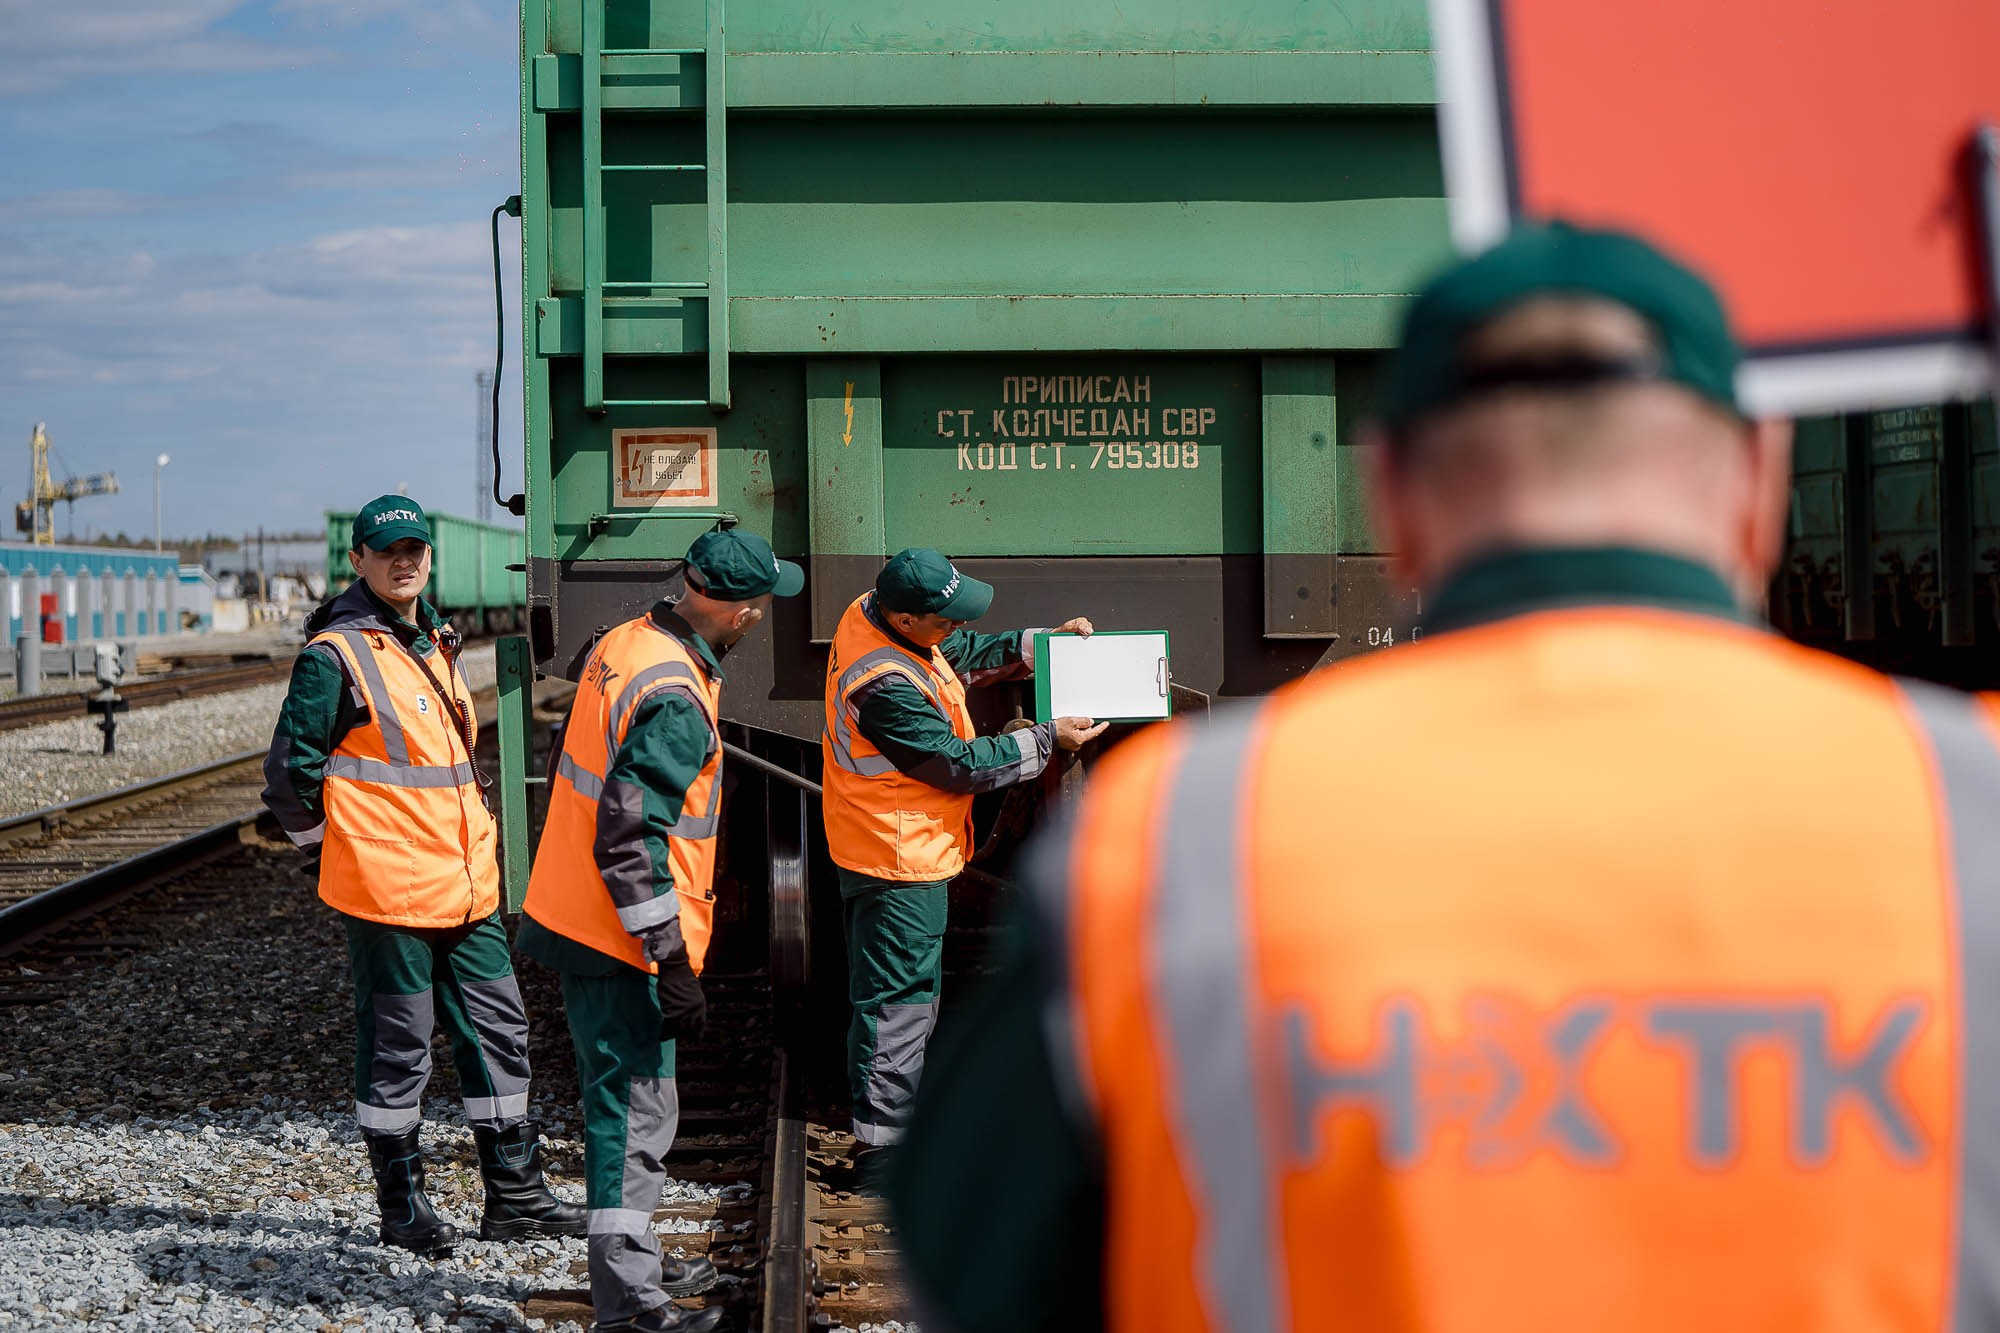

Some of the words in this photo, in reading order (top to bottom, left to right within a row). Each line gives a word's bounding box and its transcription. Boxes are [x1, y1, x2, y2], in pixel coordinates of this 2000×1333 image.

[1003, 376, 1150, 403] ПРИПИСАН
[937, 410, 980, 437] СТ.
[993, 408, 1150, 437] КОЛЧЕДАН
[1162, 408, 1216, 436] СВР
[643, 455, 655, 465] НЕ
[958, 443, 1018, 470] КОД
[1030, 442, 1076, 469] СТ.
[1089, 441, 1199, 469] 795308
[1368, 627, 1394, 647] 04
[418, 698, 428, 712] 3
